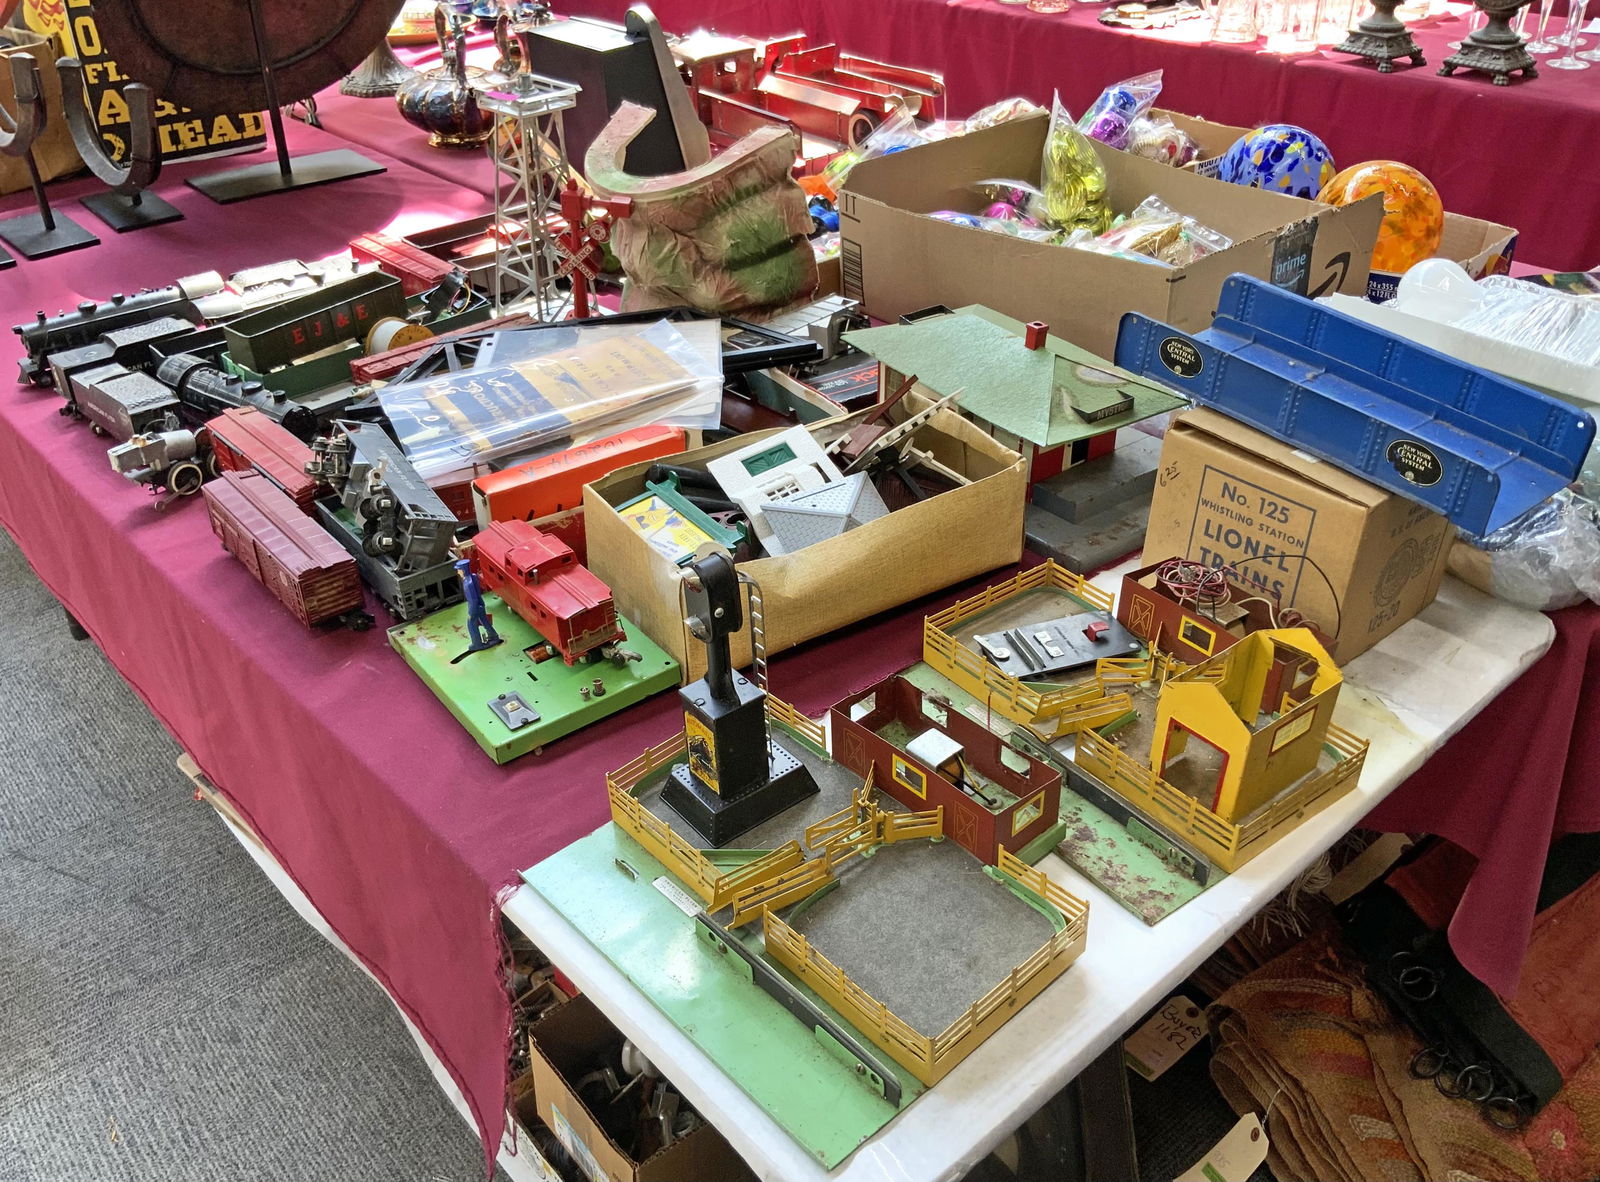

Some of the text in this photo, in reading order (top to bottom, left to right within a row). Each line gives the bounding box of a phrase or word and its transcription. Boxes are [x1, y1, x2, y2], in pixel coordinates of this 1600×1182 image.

[1275, 253, 1307, 280] prime
[1167, 343, 1195, 362] CENTRAL
[1171, 353, 1190, 365] SYSTEM
[1397, 446, 1432, 469] CENTRAL
[1401, 457, 1425, 471] SYSTEM
[1221, 481, 1290, 524] No. 125
[1201, 497, 1305, 549] WHISTLING STATION
[1203, 518, 1290, 573] LIONEL
[1199, 546, 1285, 600] TRAINS
